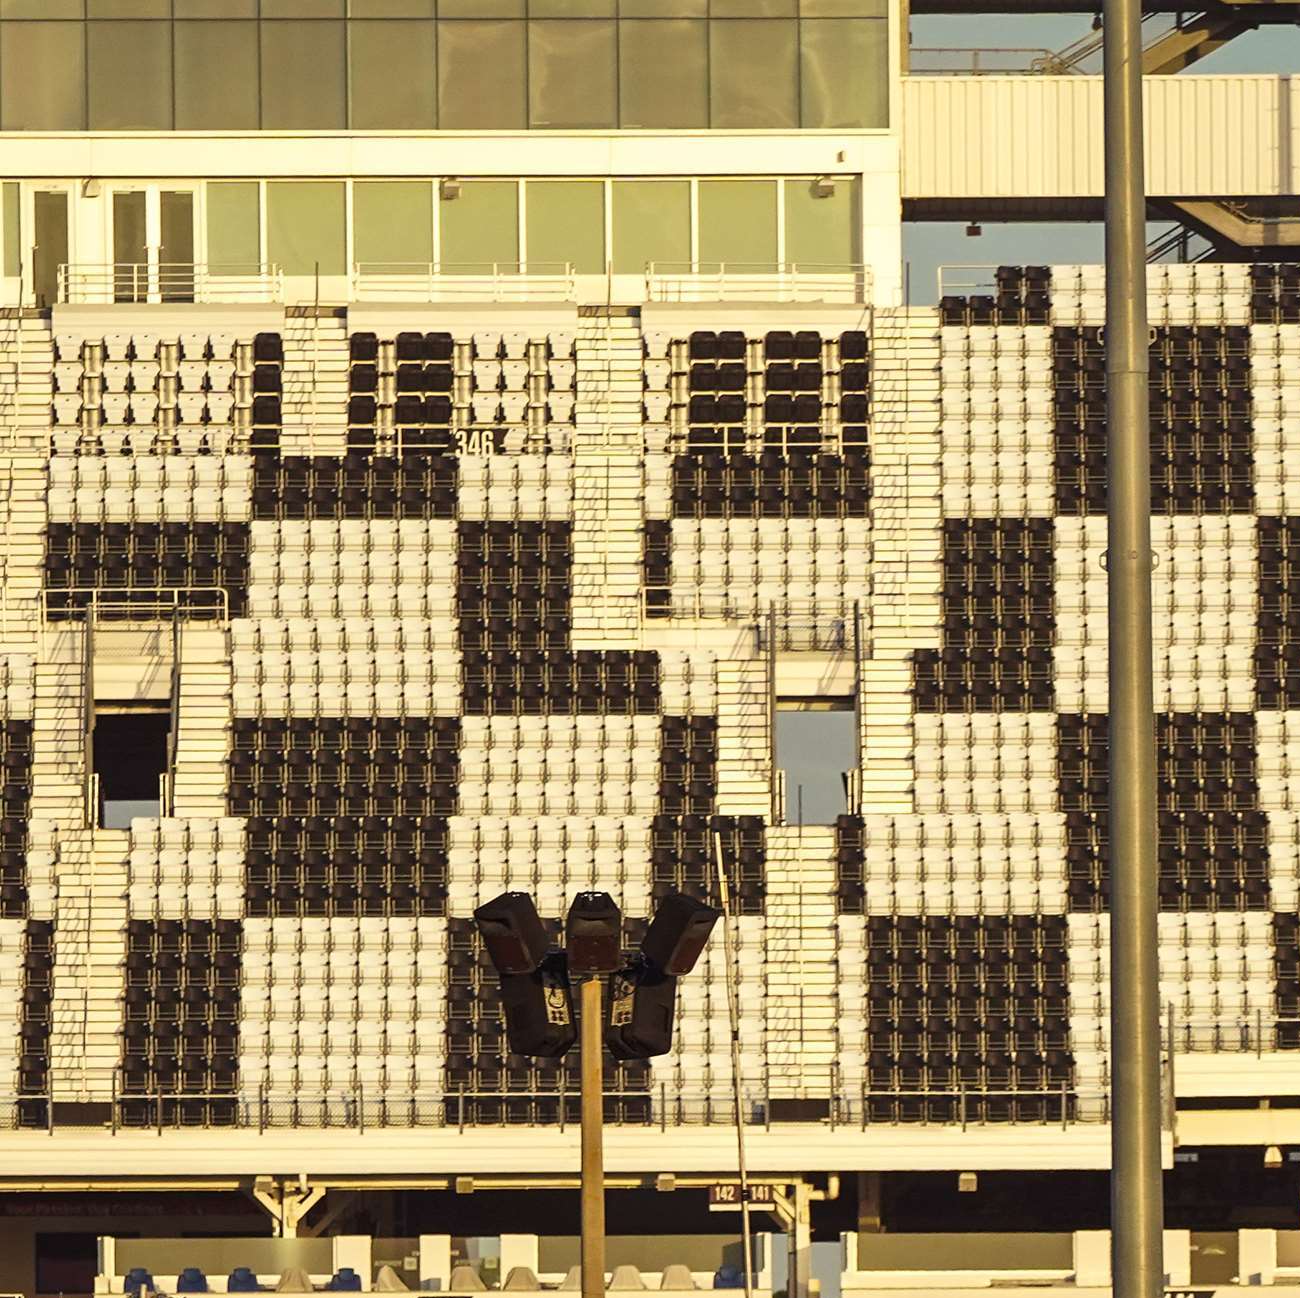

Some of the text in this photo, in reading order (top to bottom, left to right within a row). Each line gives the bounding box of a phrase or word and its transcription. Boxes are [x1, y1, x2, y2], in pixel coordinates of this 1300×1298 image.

[455, 430, 494, 457] 346
[715, 1185, 735, 1201] 142
[752, 1185, 769, 1201] 141
